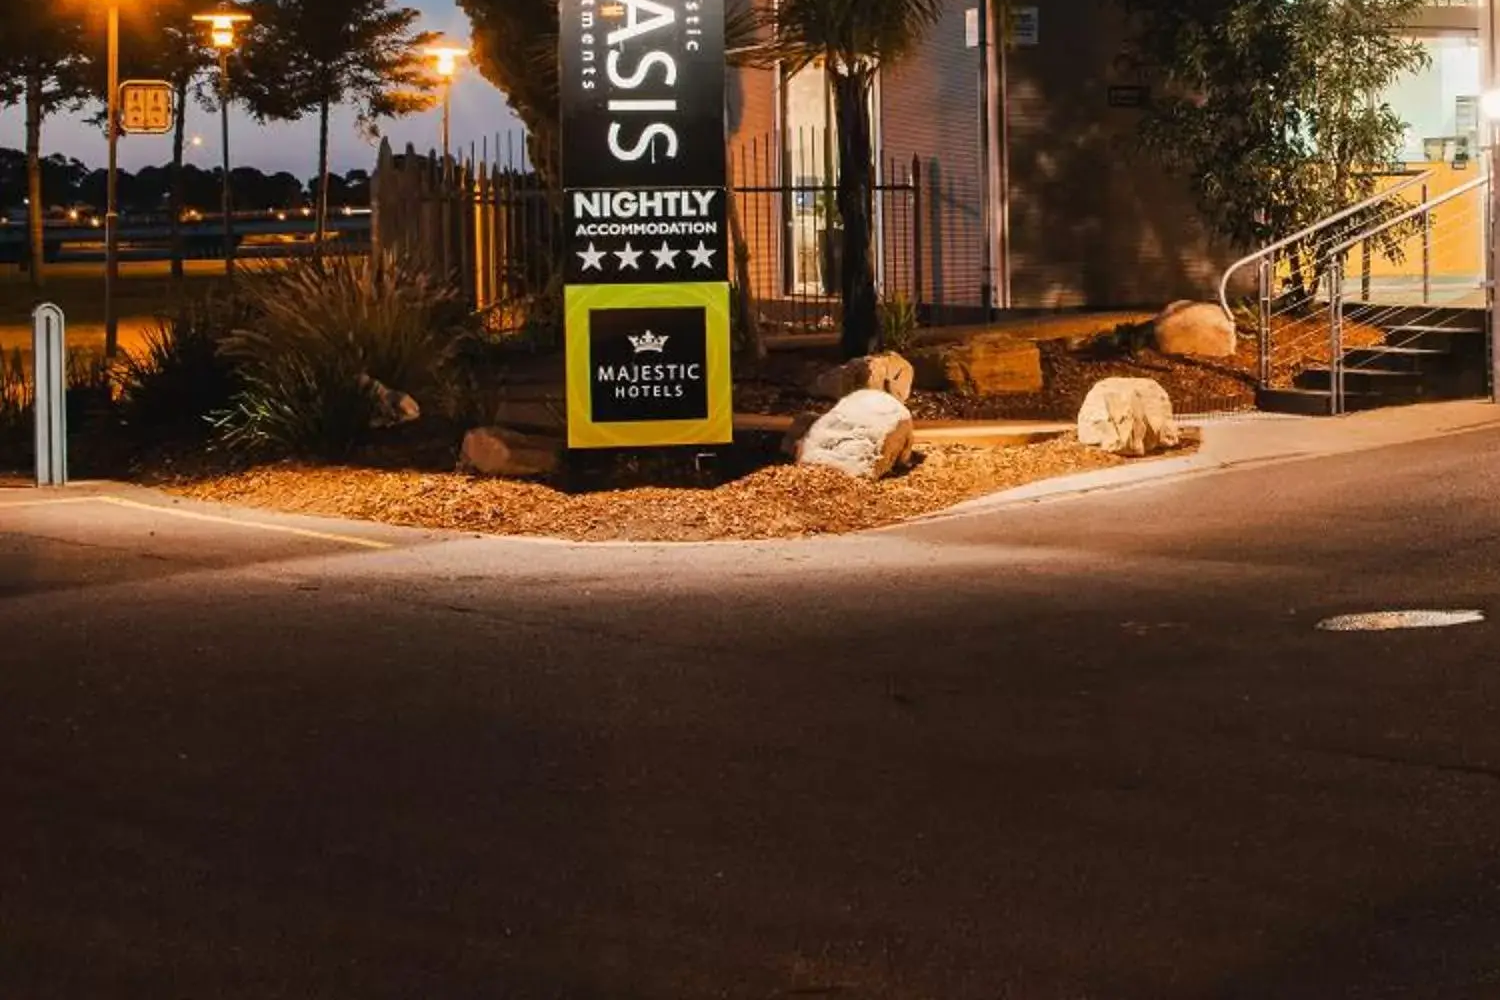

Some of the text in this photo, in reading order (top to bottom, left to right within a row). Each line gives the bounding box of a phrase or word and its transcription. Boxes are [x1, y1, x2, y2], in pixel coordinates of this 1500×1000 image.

[574, 190, 716, 218] NIGHTLY
[575, 221, 717, 237] ACCOMMODATION
[598, 363, 700, 383] MAJESTIC
[615, 385, 684, 398] HOTELS
